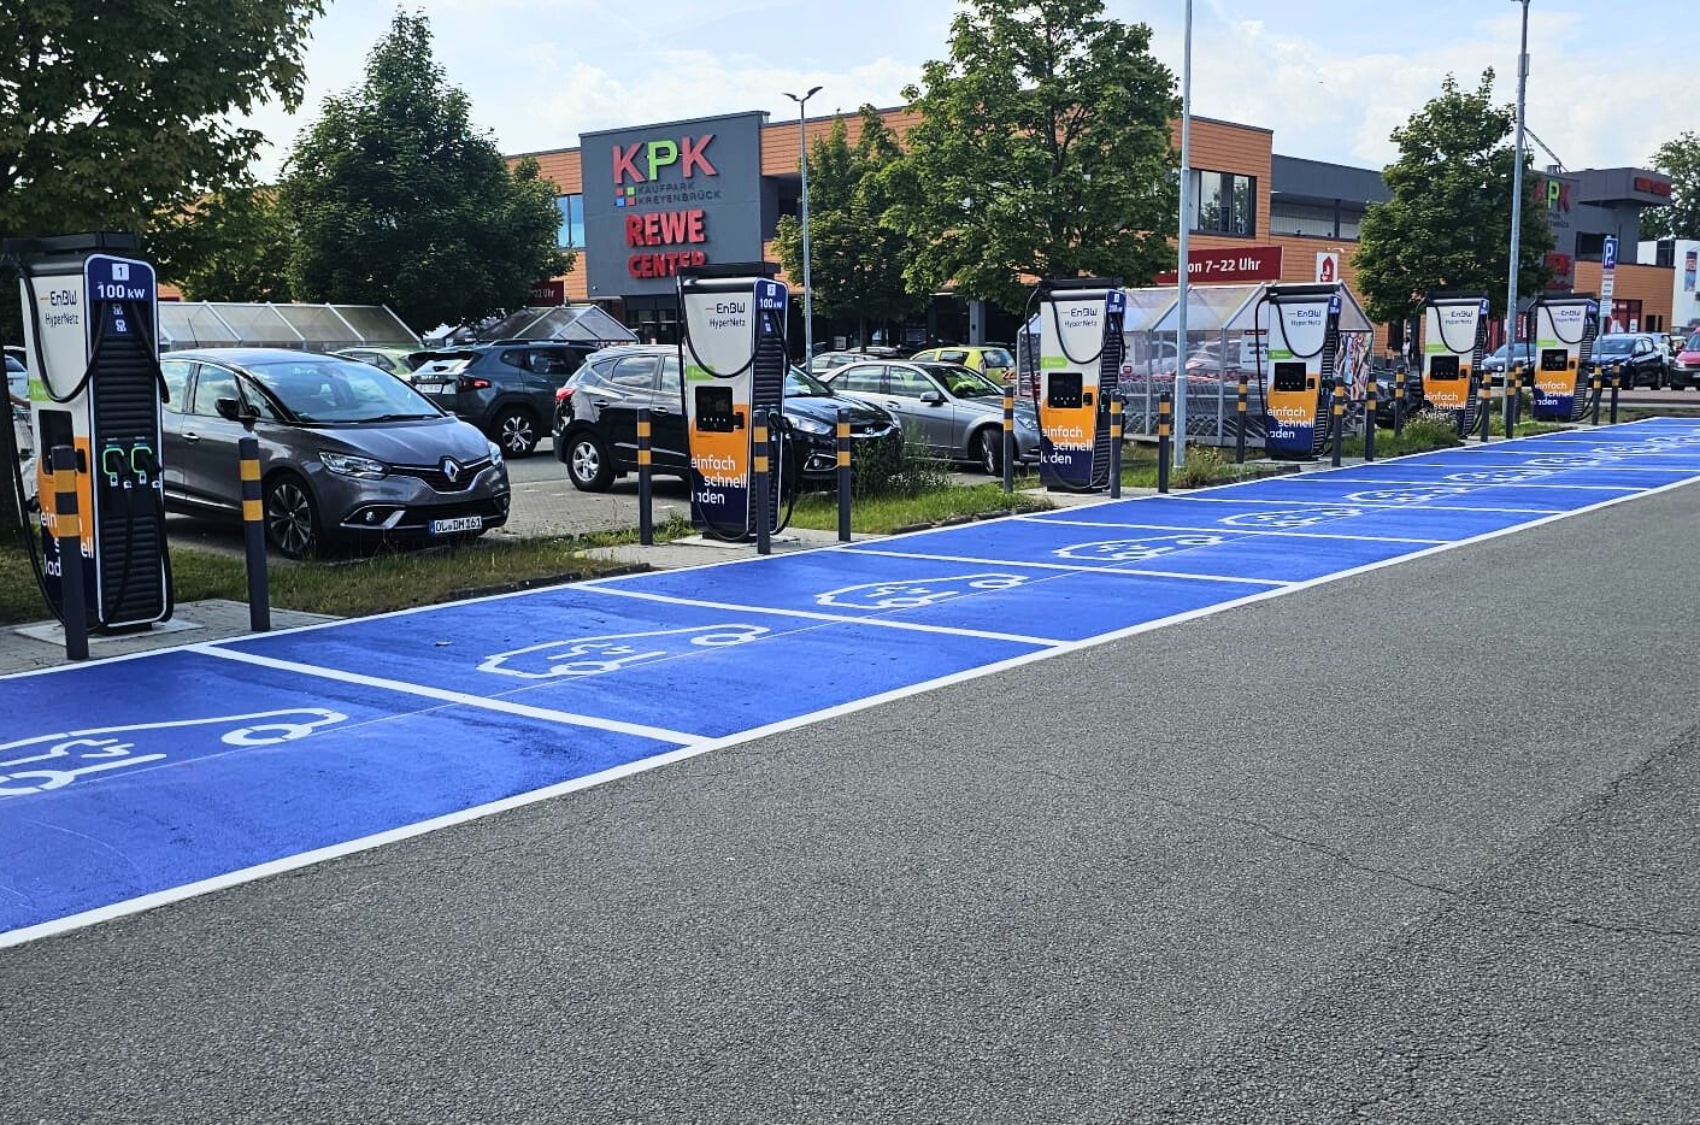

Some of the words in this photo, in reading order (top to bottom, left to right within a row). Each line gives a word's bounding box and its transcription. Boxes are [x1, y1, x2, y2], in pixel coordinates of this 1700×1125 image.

[612, 134, 718, 184] KPK
[638, 182, 695, 195] KAUFPARK
[638, 190, 722, 205] KREYENBRÜCK
[625, 210, 705, 247] REWE
[1188, 262, 1202, 273] on
[1239, 258, 1261, 271] Uhr
[50, 290, 77, 306] EnBW
[97, 284, 125, 299] 100
[127, 288, 146, 299] kW
[716, 302, 746, 314] EnBW
[760, 298, 773, 308] 100
[1070, 308, 1098, 317] EnBW
[1297, 310, 1321, 318] EnBW
[45, 313, 79, 328] HyperNetz
[709, 318, 746, 329] HyperNetz
[1267, 406, 1306, 417] einfach
[1278, 418, 1314, 428] schnell
[1042, 425, 1083, 438] einfach
[1266, 429, 1295, 439] aden
[1052, 439, 1093, 452] schnell
[691, 454, 736, 471] einfach
[704, 472, 747, 489] schnell
[465, 517, 482, 529] 161
[54, 536, 94, 559] sell
[44, 553, 62, 577] lad
